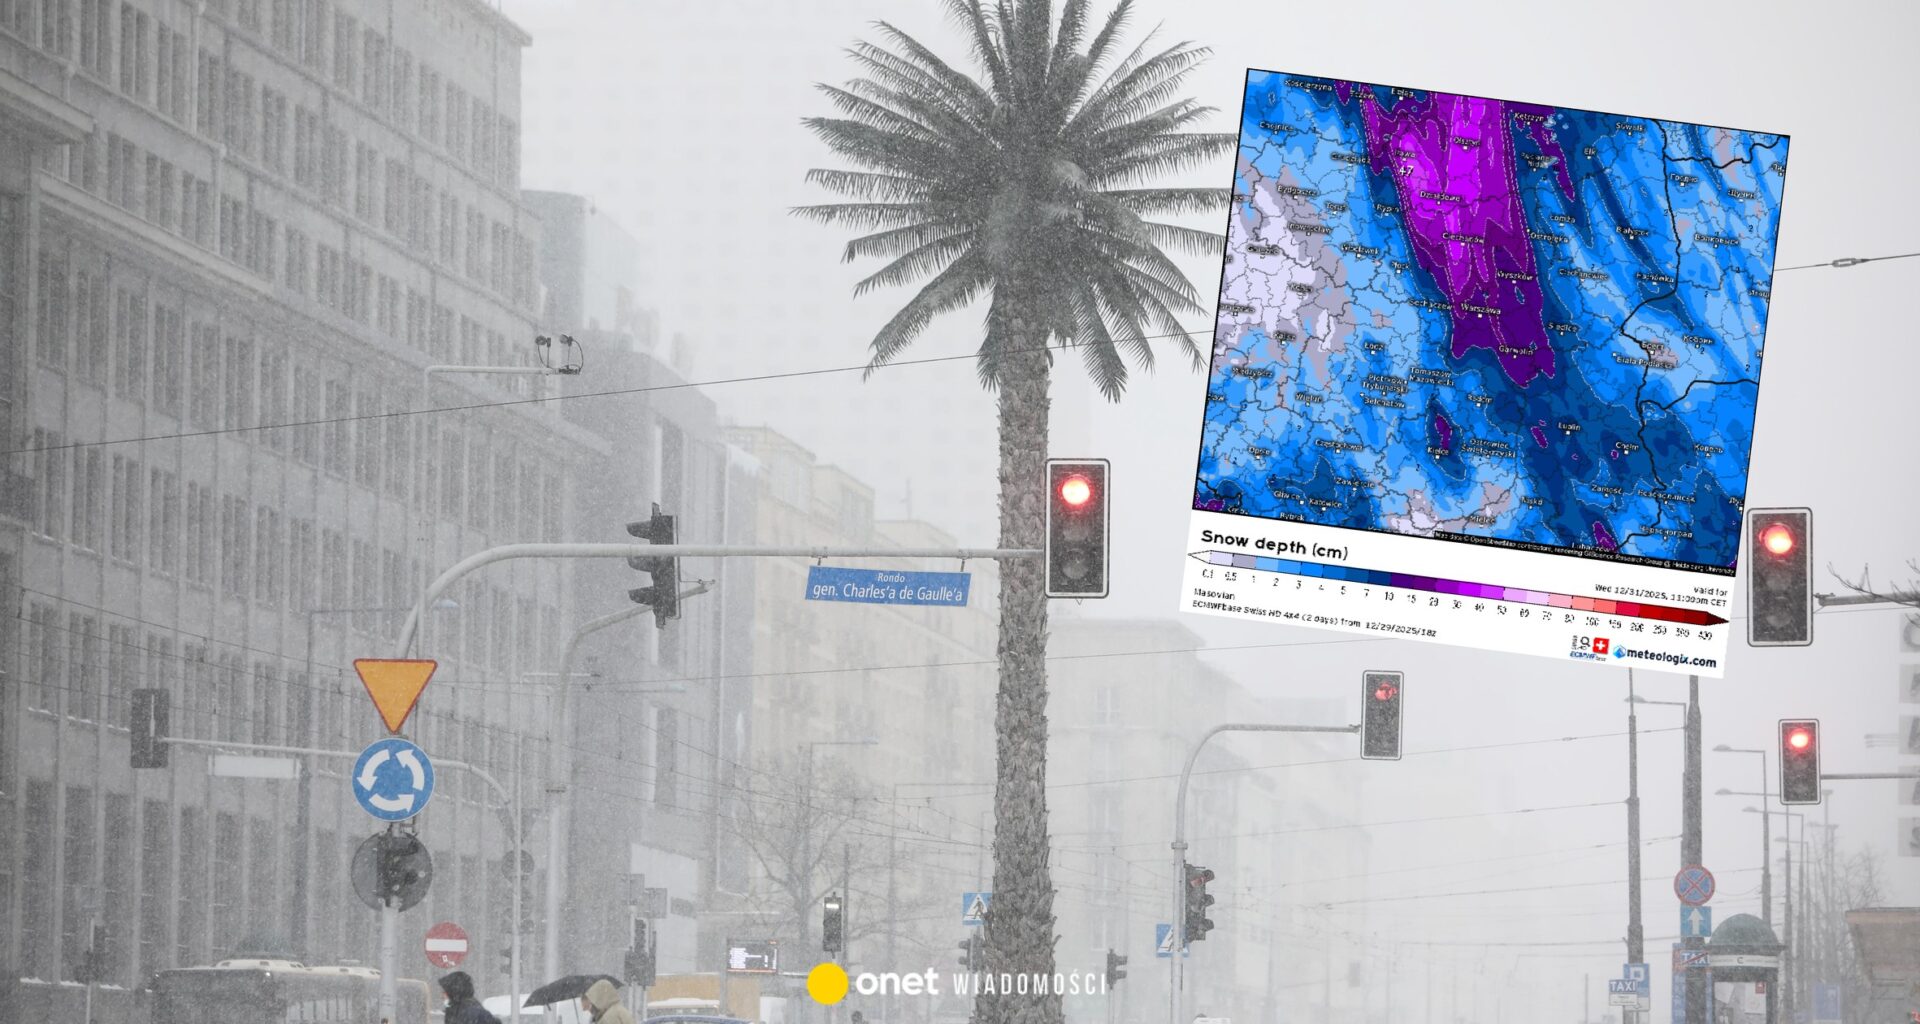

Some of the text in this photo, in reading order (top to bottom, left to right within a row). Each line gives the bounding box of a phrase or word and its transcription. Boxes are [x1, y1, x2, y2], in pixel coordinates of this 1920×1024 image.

[877, 573, 905, 583] Rondo
[813, 584, 838, 599] gen.
[898, 586, 914, 600] de
[1610, 982, 1636, 993] TAXI
